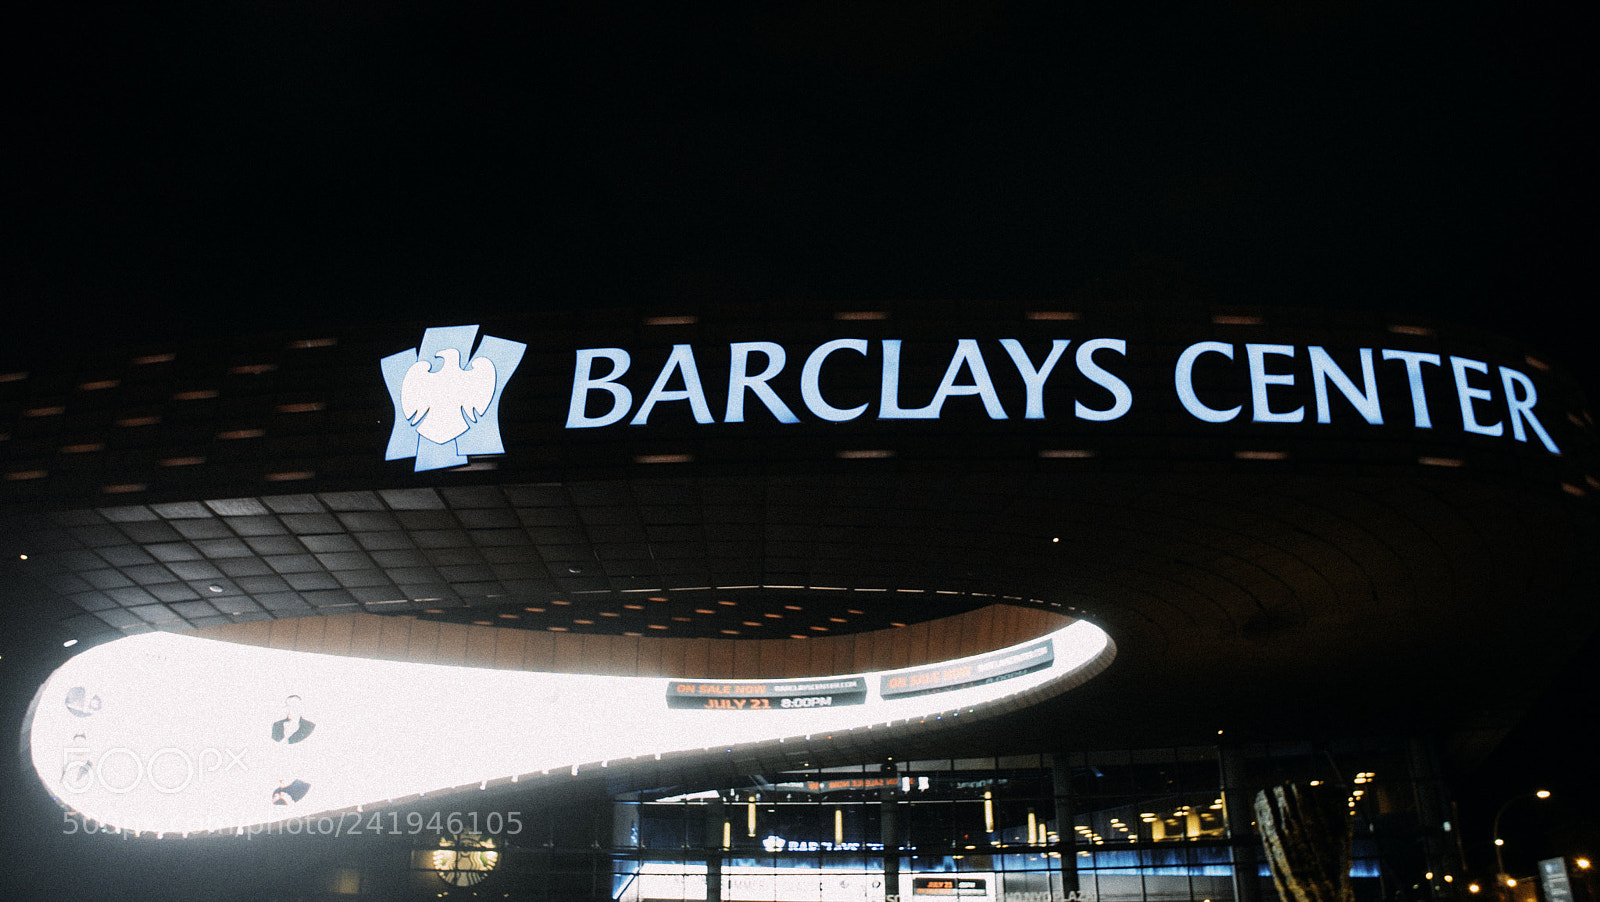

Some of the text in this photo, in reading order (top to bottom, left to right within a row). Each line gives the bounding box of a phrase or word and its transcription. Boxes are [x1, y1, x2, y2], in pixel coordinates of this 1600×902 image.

[565, 338, 1560, 455] BARCLAYS CENTER
[676, 684, 696, 694] ON
[698, 684, 732, 694] SALE
[735, 685, 768, 694] NOW
[704, 696, 833, 710] JULY 21 8:00PM
